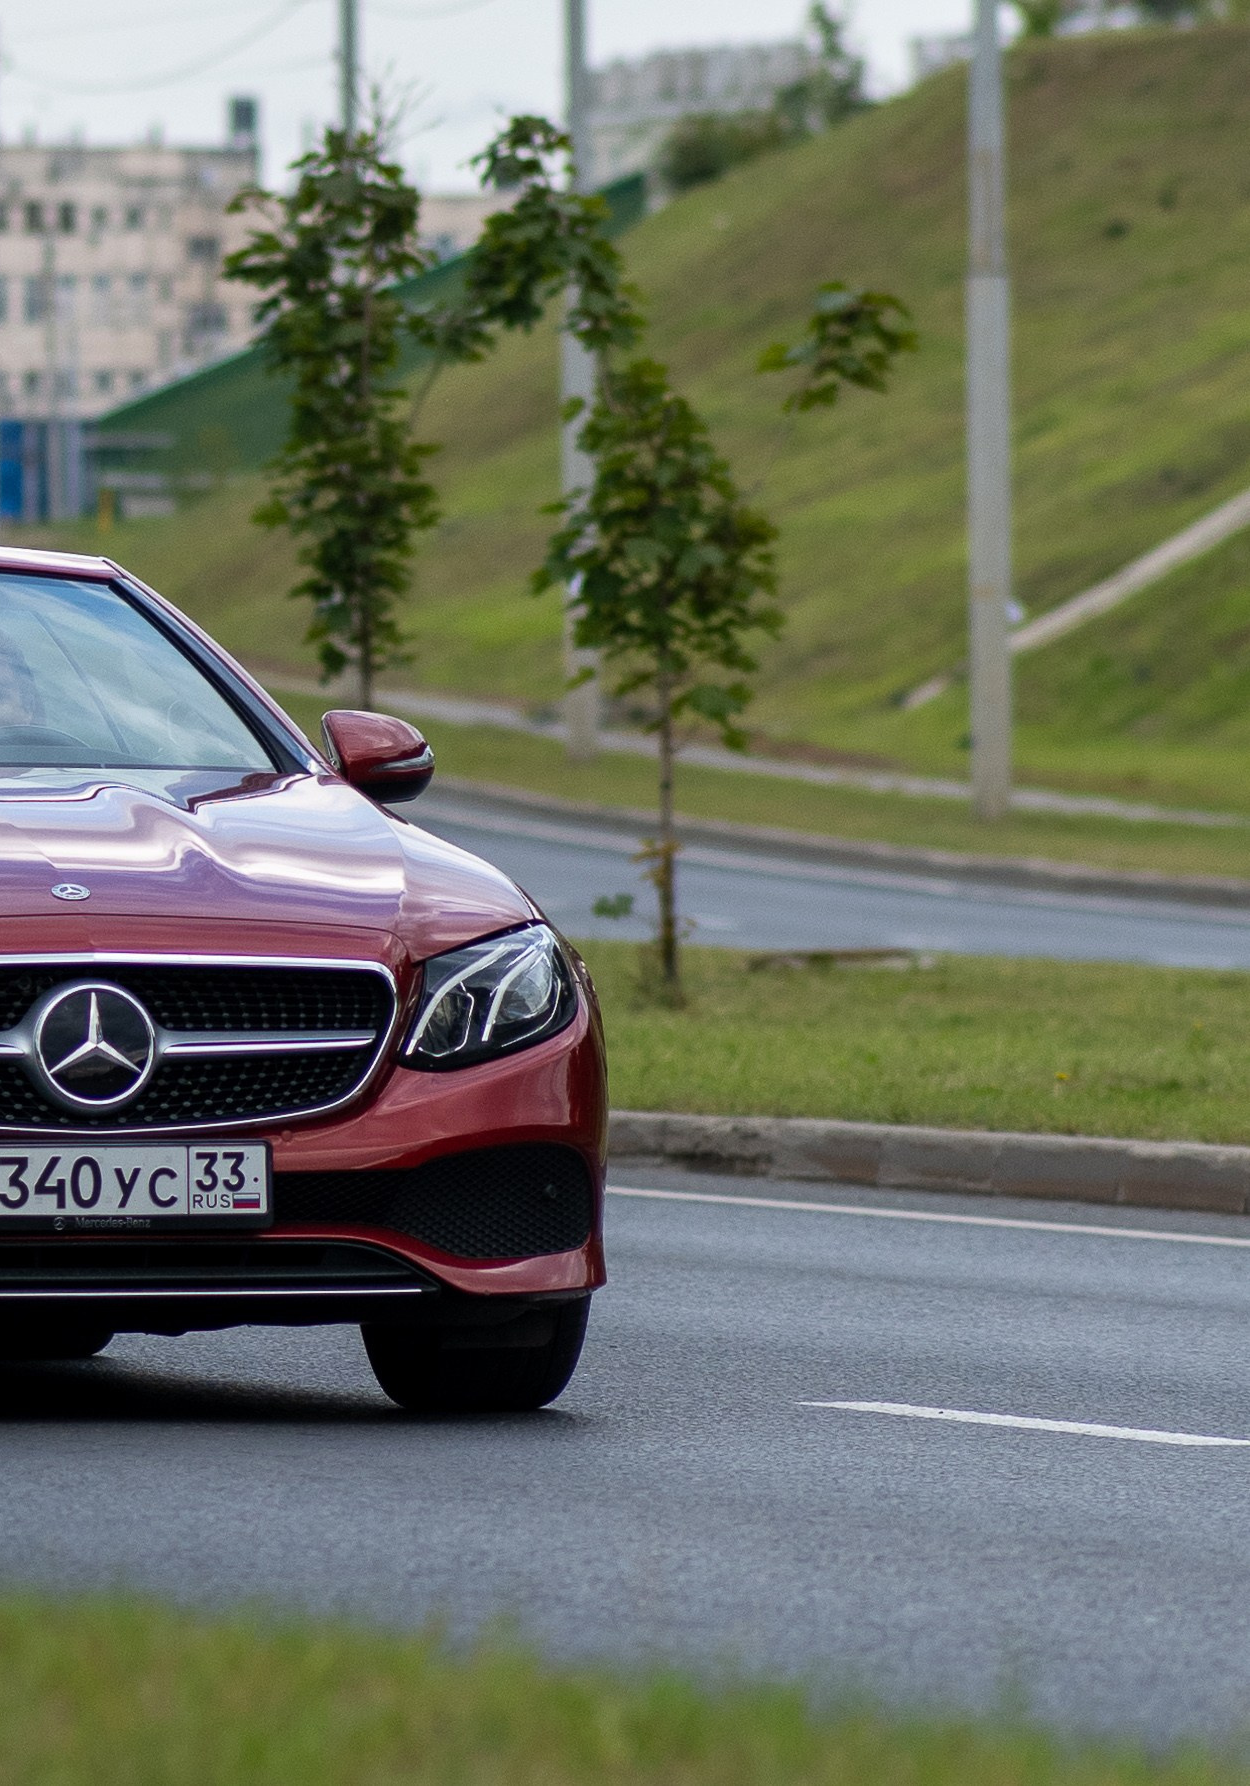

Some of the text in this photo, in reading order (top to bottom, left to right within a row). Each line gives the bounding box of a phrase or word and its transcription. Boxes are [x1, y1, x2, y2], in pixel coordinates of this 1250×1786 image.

[195, 1151, 246, 1193] 33
[192, 1193, 231, 1209] RUS
[74, 1216, 151, 1229] Mercedes-Benz
